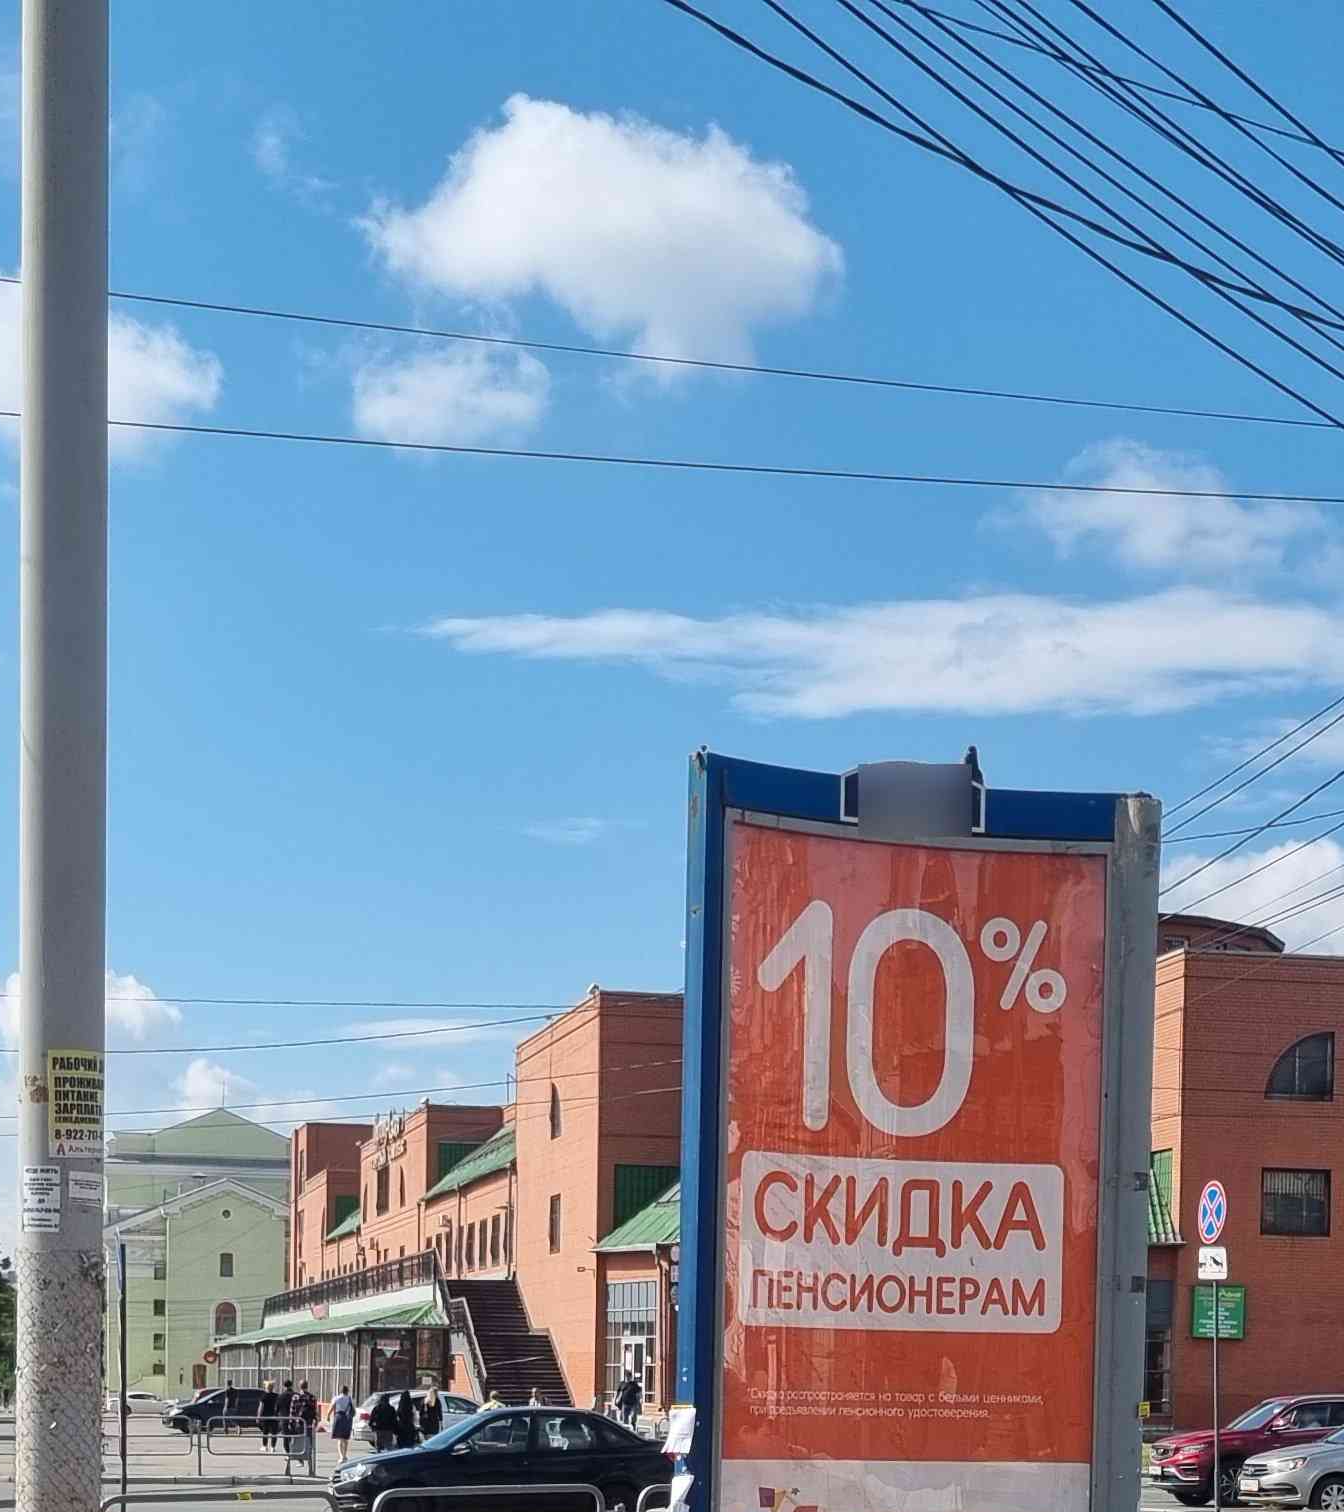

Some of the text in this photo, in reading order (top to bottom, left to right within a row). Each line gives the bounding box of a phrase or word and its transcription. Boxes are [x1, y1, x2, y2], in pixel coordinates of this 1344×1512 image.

[757, 898, 1067, 1138] 10%
[51, 1056, 98, 1072] РАБОЧИЙ
[54, 1089, 99, 1103] ПИТАНИЕ
[754, 1170, 1047, 1258] СКИДКА
[750, 1269, 1045, 1317] ПЕНСИОНЕРАМ
